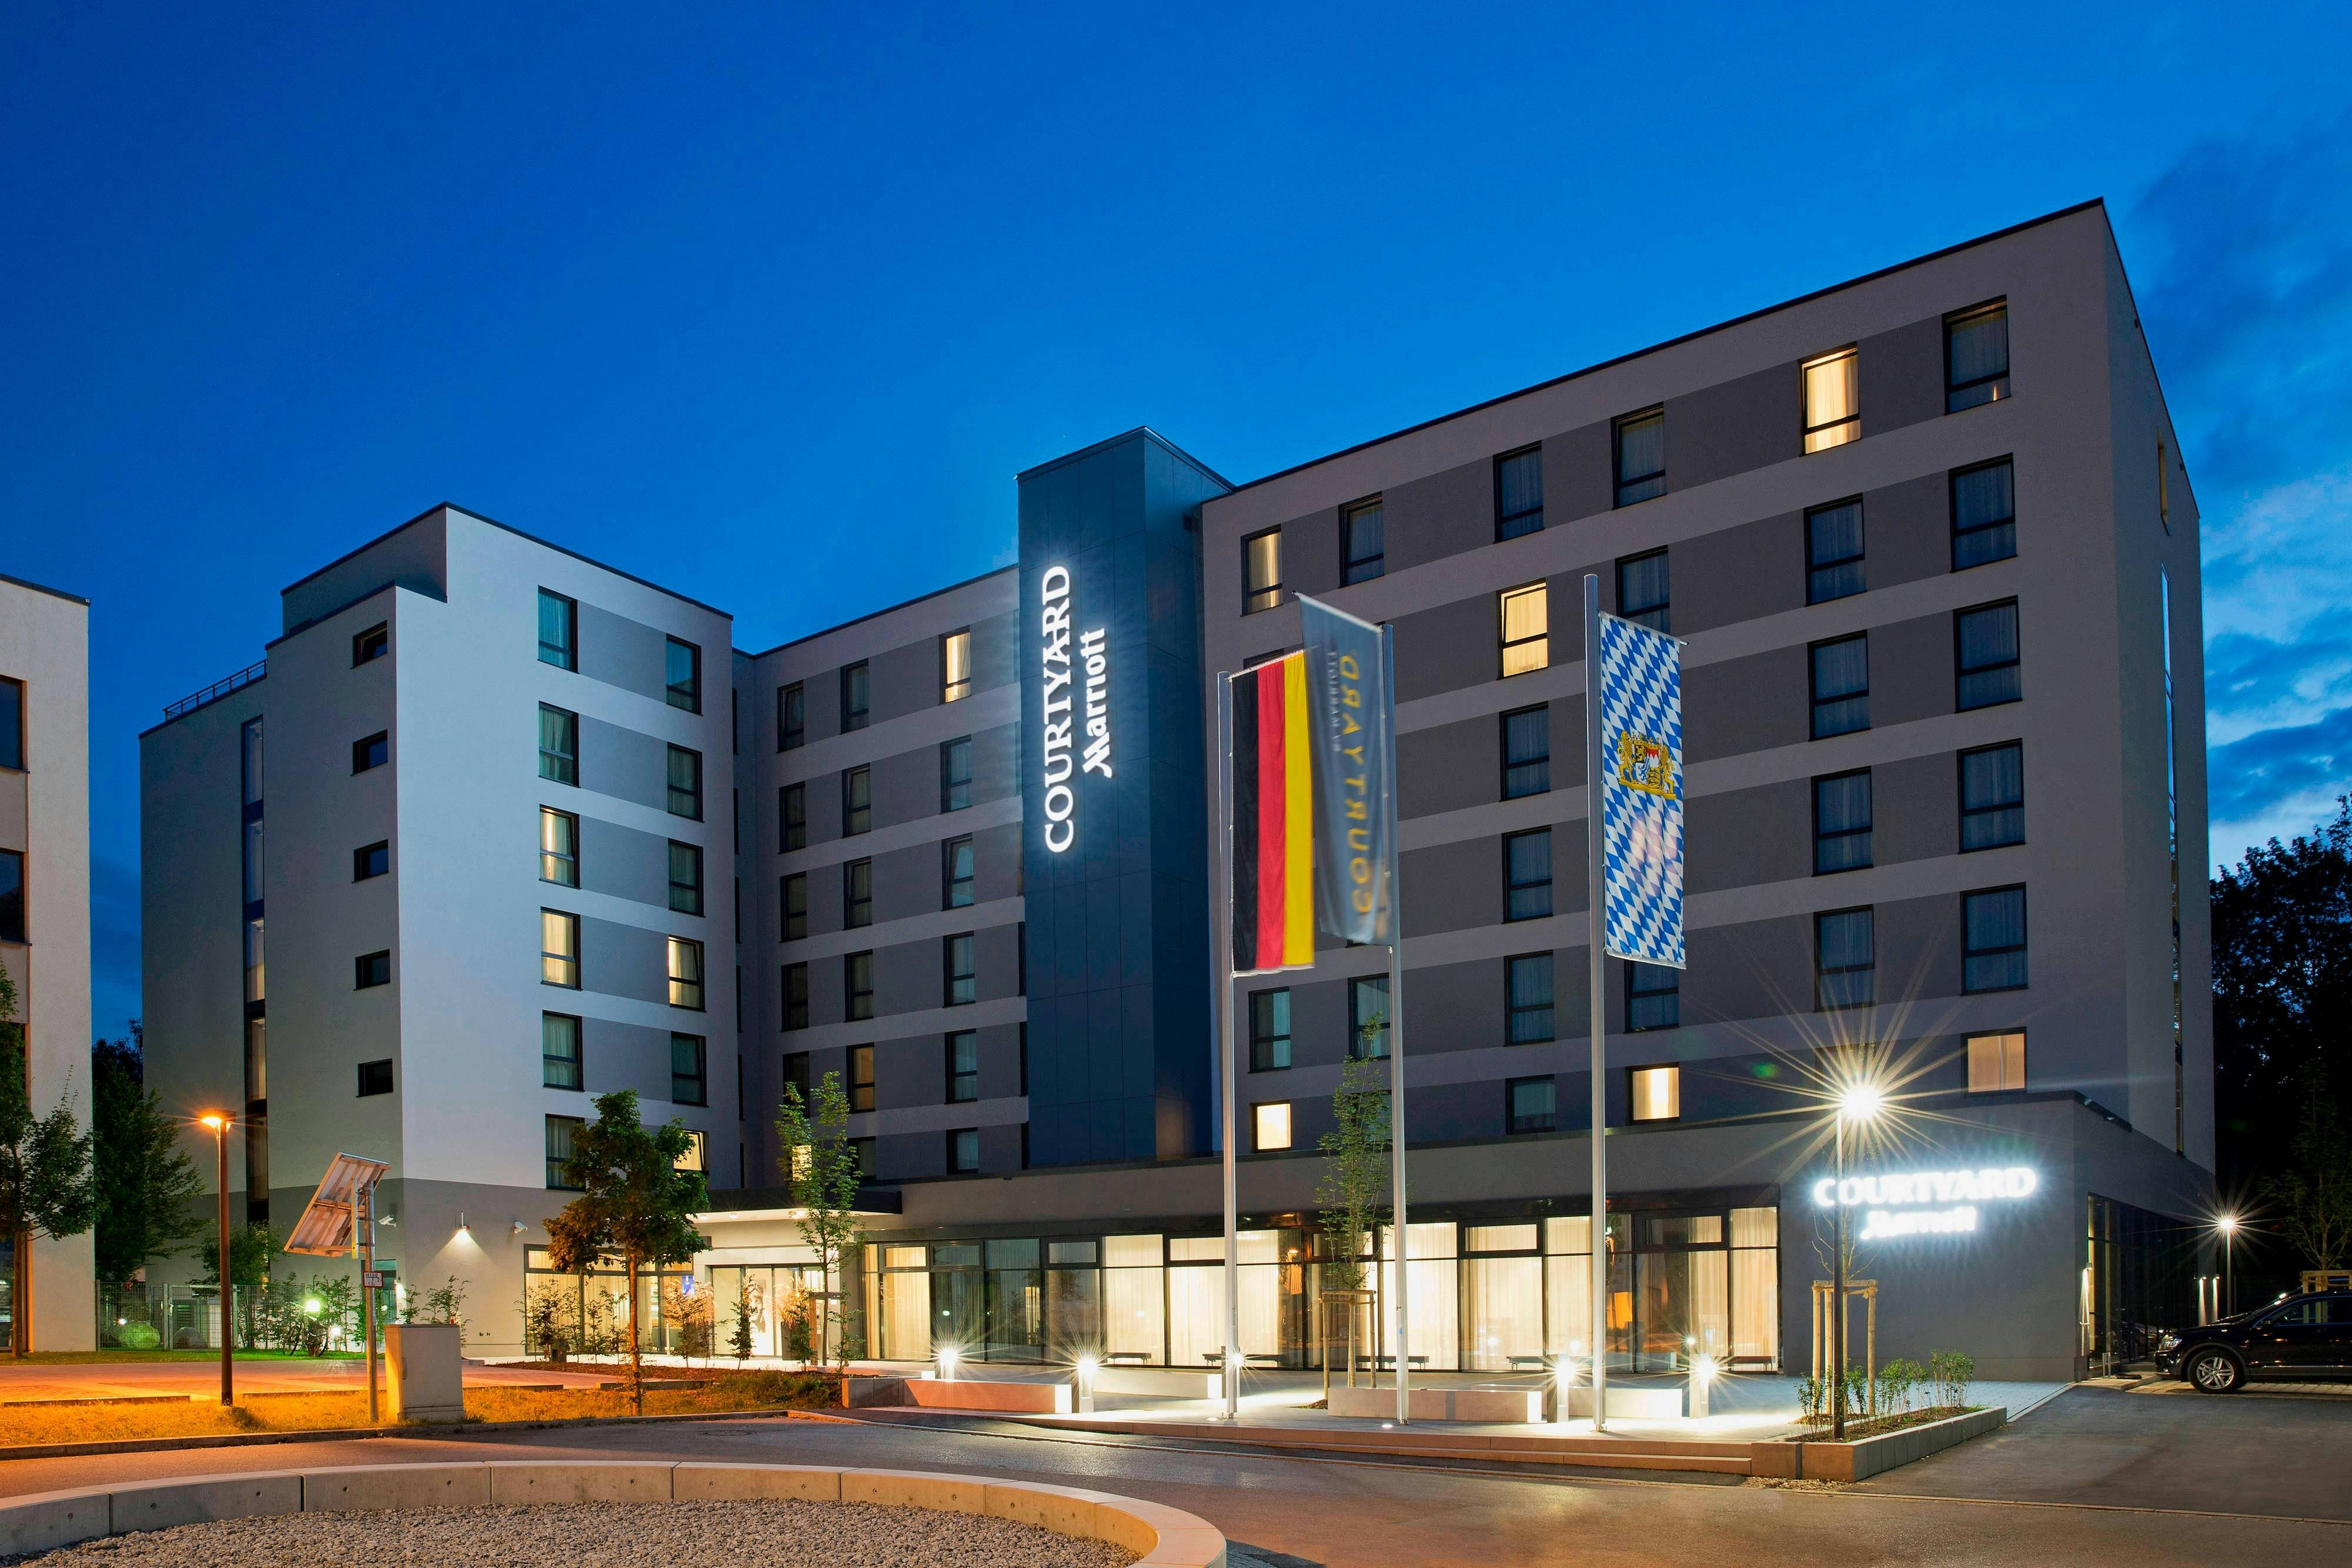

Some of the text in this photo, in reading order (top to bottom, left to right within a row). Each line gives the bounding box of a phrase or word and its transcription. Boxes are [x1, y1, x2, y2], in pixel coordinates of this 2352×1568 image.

[1042, 566, 1074, 852] COURTYARD
[1081, 628, 1112, 778] Marriott
[1814, 1168, 2037, 1206] COURTYARD
